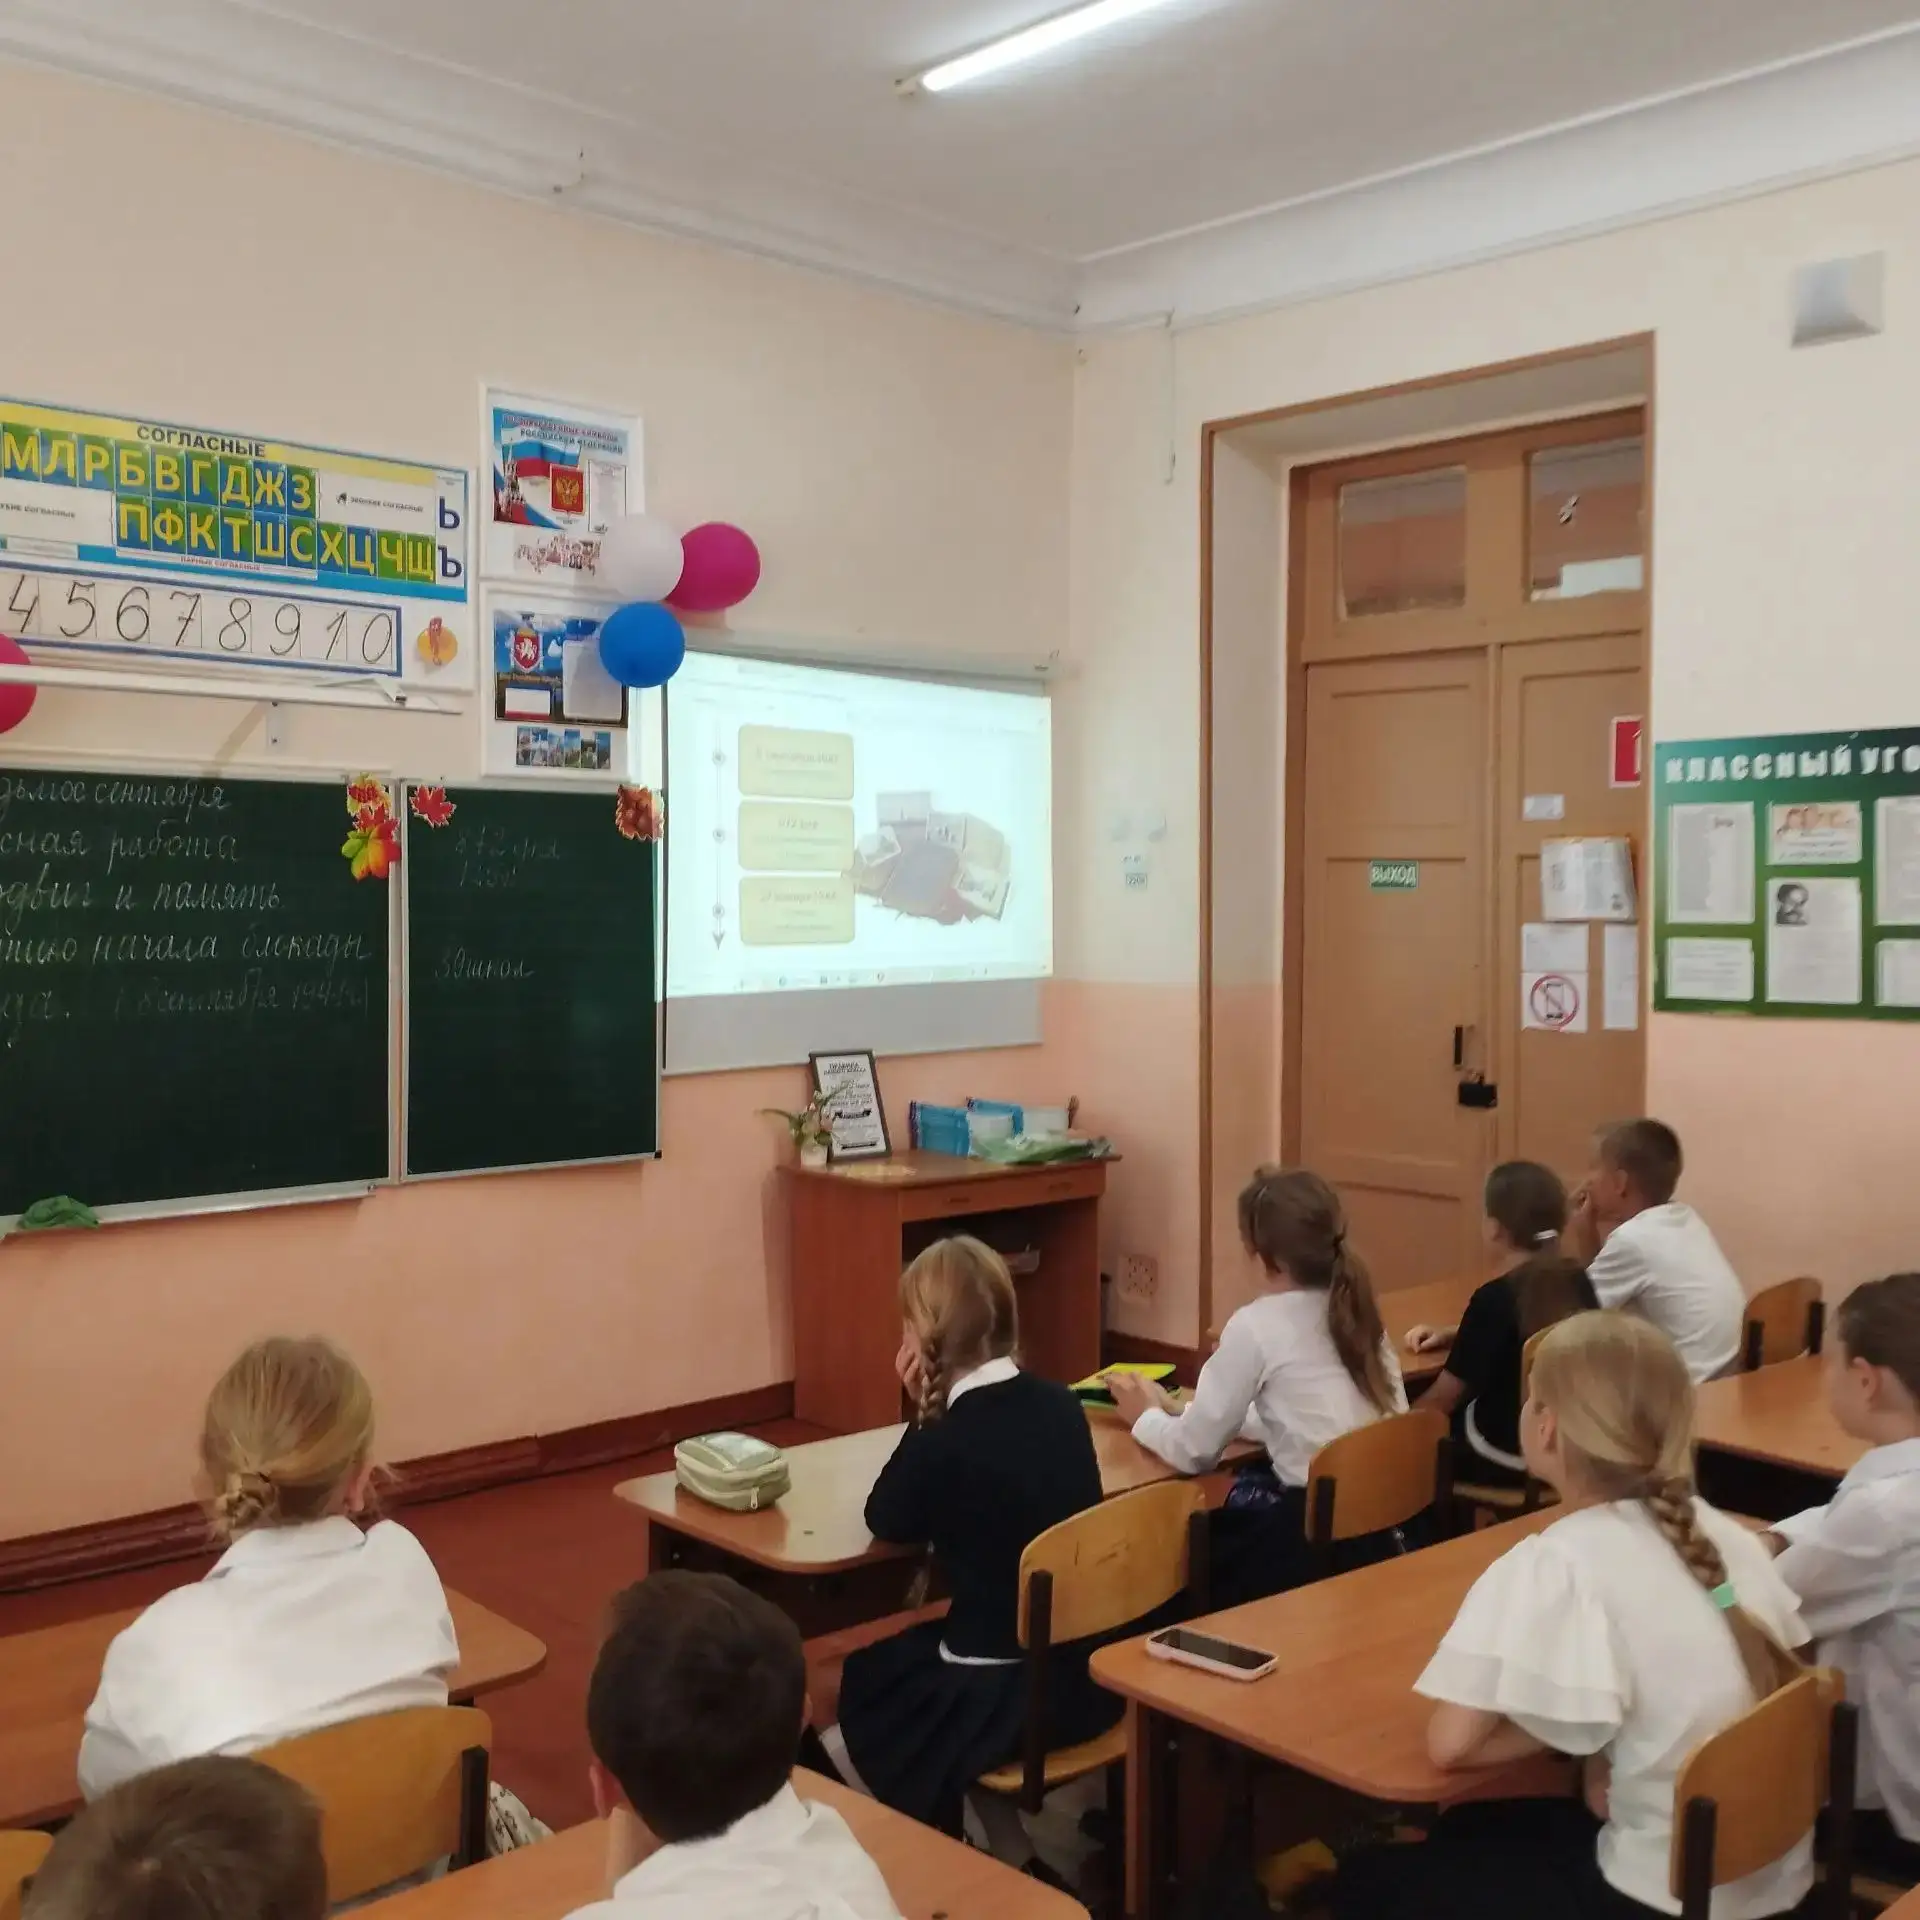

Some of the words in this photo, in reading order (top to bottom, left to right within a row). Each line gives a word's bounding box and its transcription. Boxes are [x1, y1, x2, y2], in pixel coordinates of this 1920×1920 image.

[137, 424, 266, 458] СОГЛАСНЫЕ
[438, 495, 461, 530] Ь
[437, 544, 463, 578] Ъ
[1666, 744, 1852, 783] КЛАССНЫЙ
[95, 778, 231, 823] сентября
[107, 819, 243, 876] работа
[1368, 866, 1417, 886] ВЫХОД
[115, 884, 136, 910] и
[153, 881, 284, 912] память
[92, 935, 220, 964] начала
